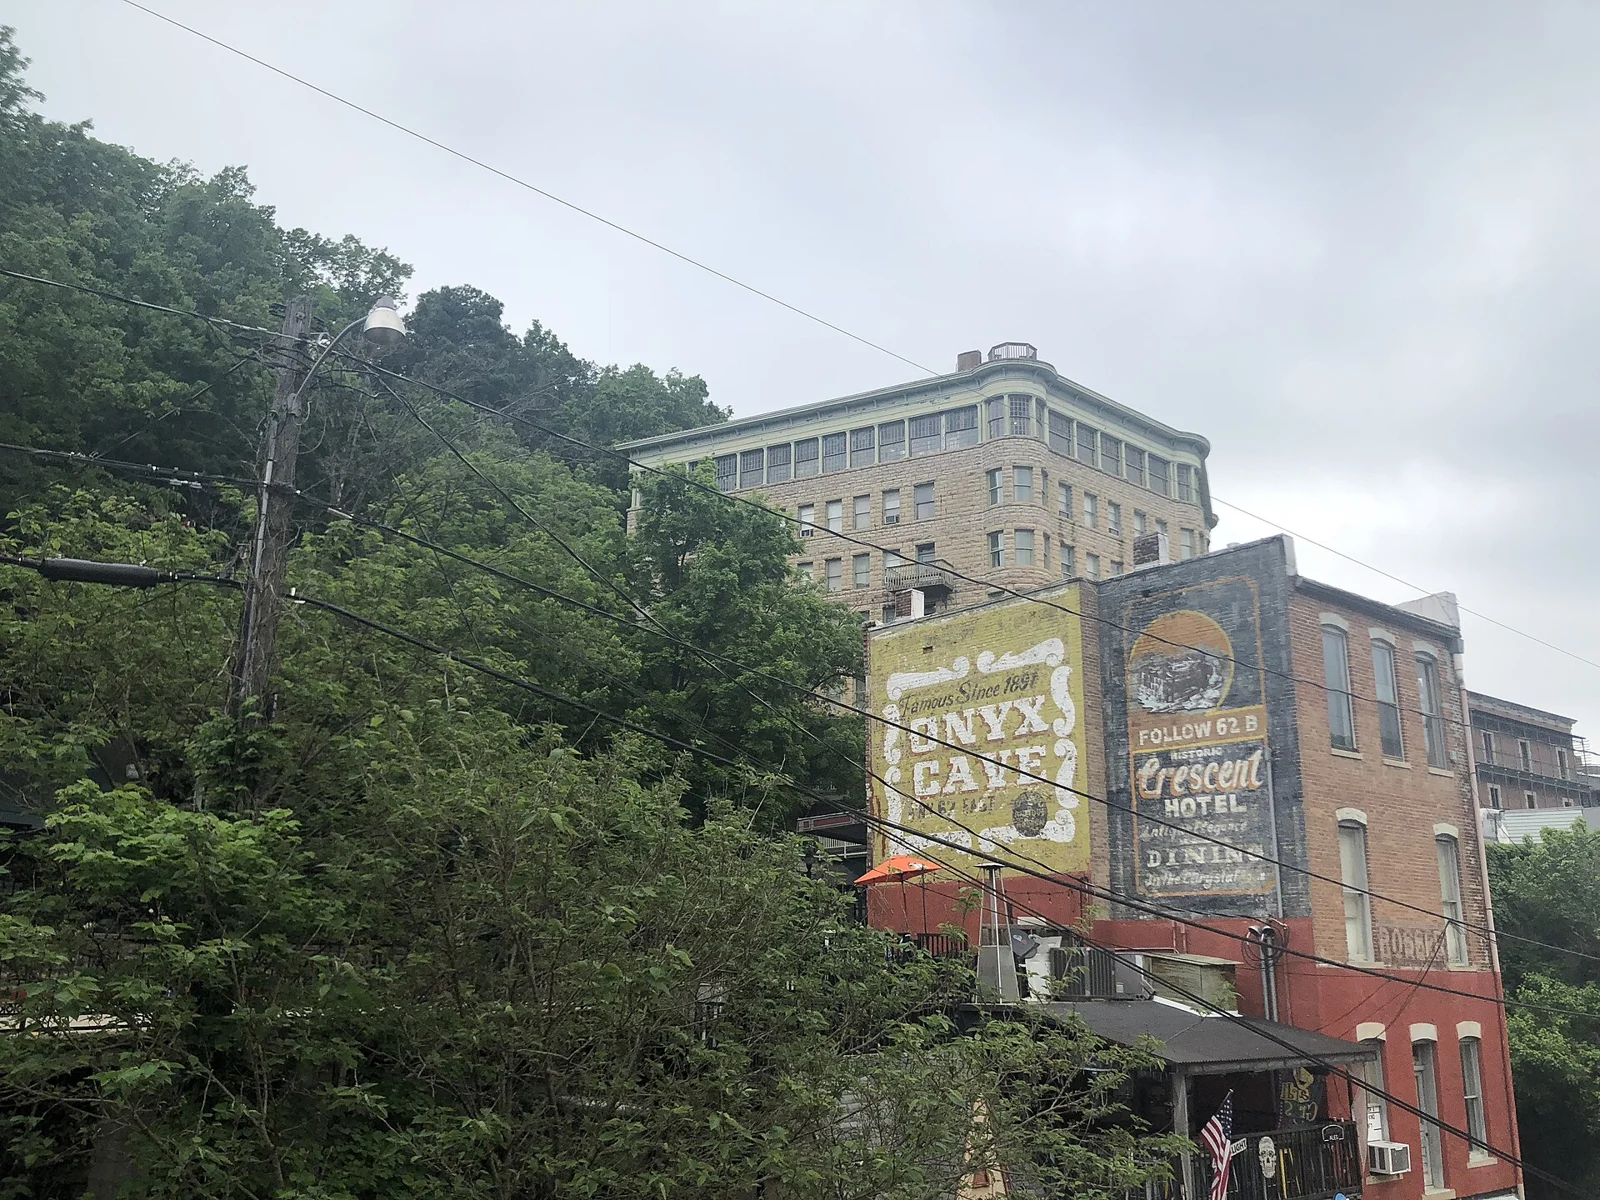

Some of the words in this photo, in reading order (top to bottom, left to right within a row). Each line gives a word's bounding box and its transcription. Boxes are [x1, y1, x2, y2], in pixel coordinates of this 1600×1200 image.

[899, 693, 953, 717] Famous
[955, 680, 1000, 704] Since
[909, 695, 1050, 753] ONYX
[1139, 720, 1212, 746] FOLLOW
[1216, 717, 1241, 736] 62
[1245, 715, 1259, 732] B
[911, 746, 1047, 797] CAVE
[1170, 746, 1222, 760] HISTORIC
[1137, 750, 1264, 797] Crescent
[1164, 794, 1247, 817] HOTEL
